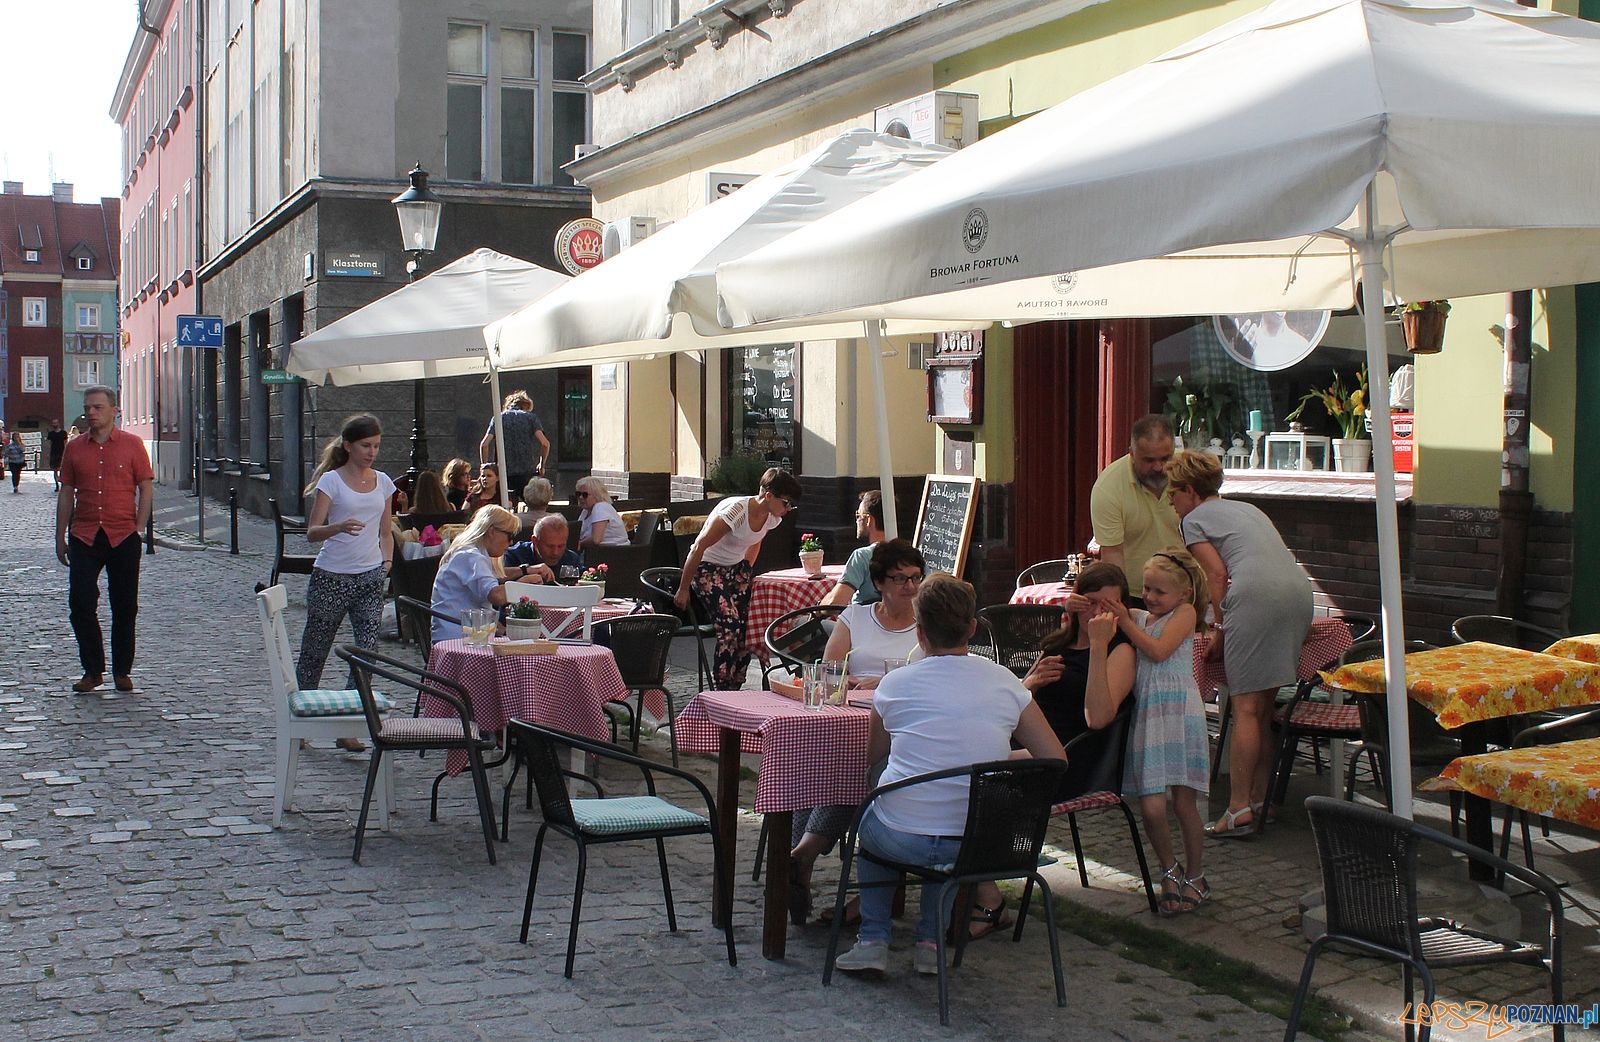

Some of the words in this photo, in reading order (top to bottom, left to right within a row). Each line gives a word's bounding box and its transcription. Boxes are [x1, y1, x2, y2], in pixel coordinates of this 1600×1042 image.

[332, 259, 378, 268] Klasztorna
[930, 263, 970, 278] BROWAR
[973, 254, 1019, 271] FORTUNA
